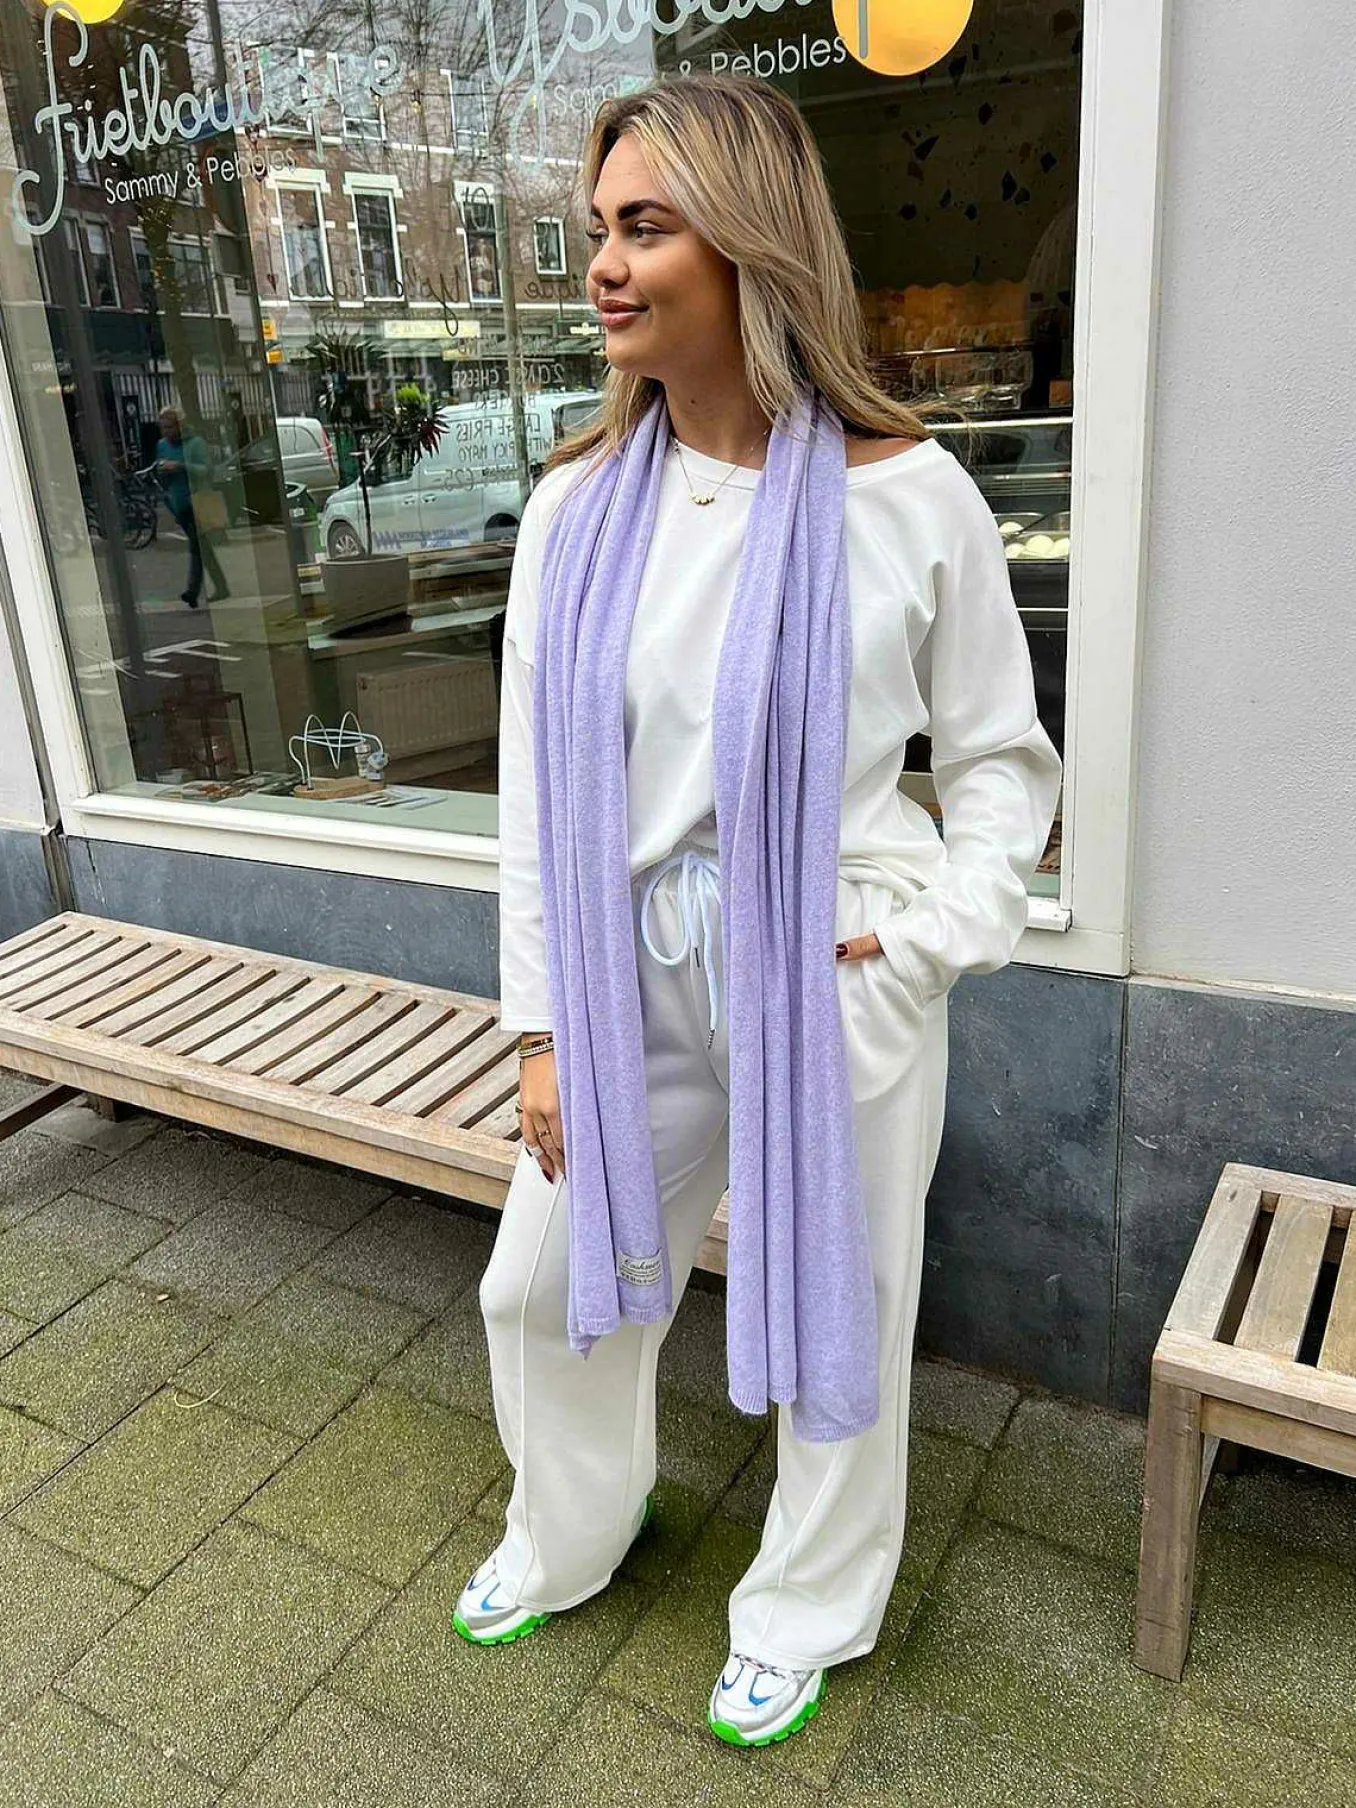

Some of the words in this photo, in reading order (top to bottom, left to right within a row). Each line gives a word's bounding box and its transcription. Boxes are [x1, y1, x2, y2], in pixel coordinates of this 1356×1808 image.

[710, 33, 848, 79] Pebbles
[104, 170, 179, 205] Sammy
[186, 162, 203, 189] &
[206, 146, 297, 185] Pebbles
